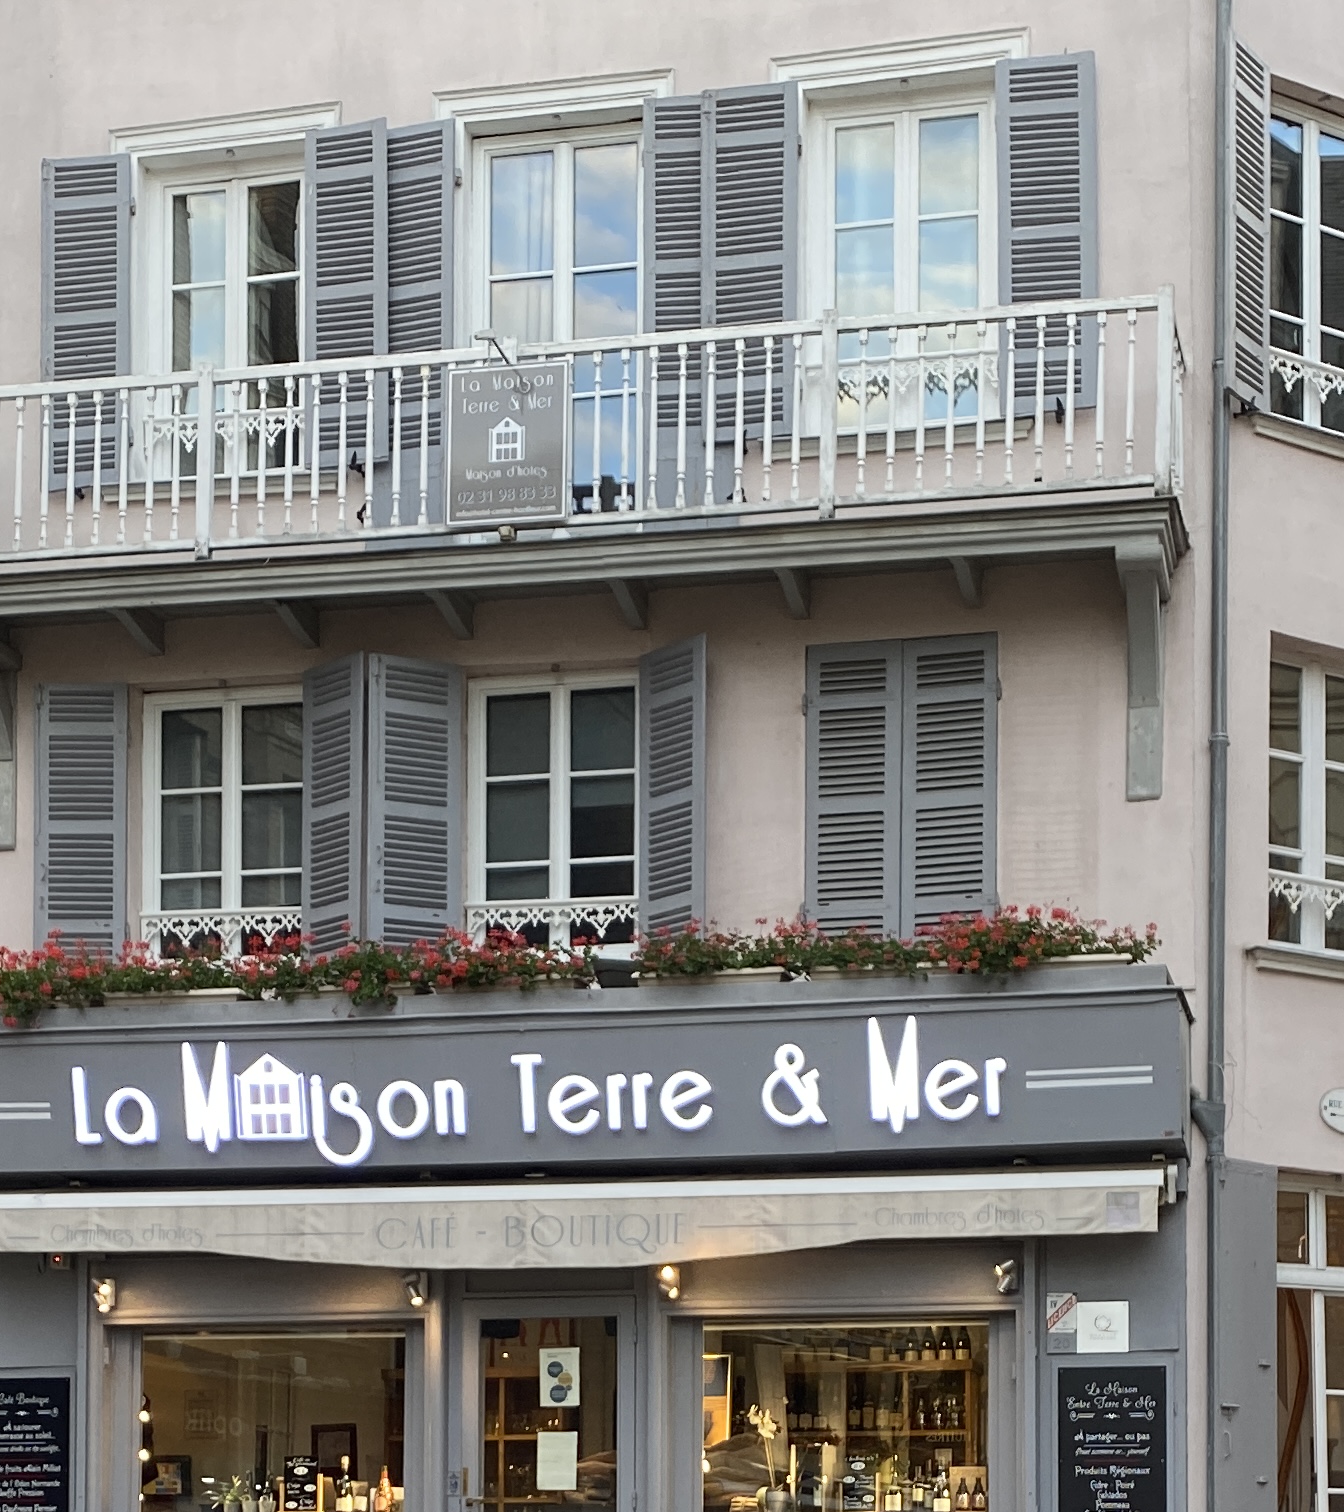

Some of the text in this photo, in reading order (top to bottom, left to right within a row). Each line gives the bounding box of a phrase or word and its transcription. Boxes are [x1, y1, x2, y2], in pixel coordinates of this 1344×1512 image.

[461, 373, 554, 393] La Maison
[462, 392, 552, 414] Terre & Mer
[457, 485, 556, 505] 02 31 98 83 33
[71, 1066, 159, 1145] La
[510, 1053, 714, 1135] Terre
[761, 1042, 829, 1128] &
[867, 1015, 1007, 1134] Mer
[874, 1207, 967, 1231] Chambres
[51, 1223, 134, 1248] Chambres
[376, 1211, 456, 1250] CAFÉ
[506, 1212, 685, 1254] BOUTIQUE
[1074, 1465, 1107, 1477] Produits
